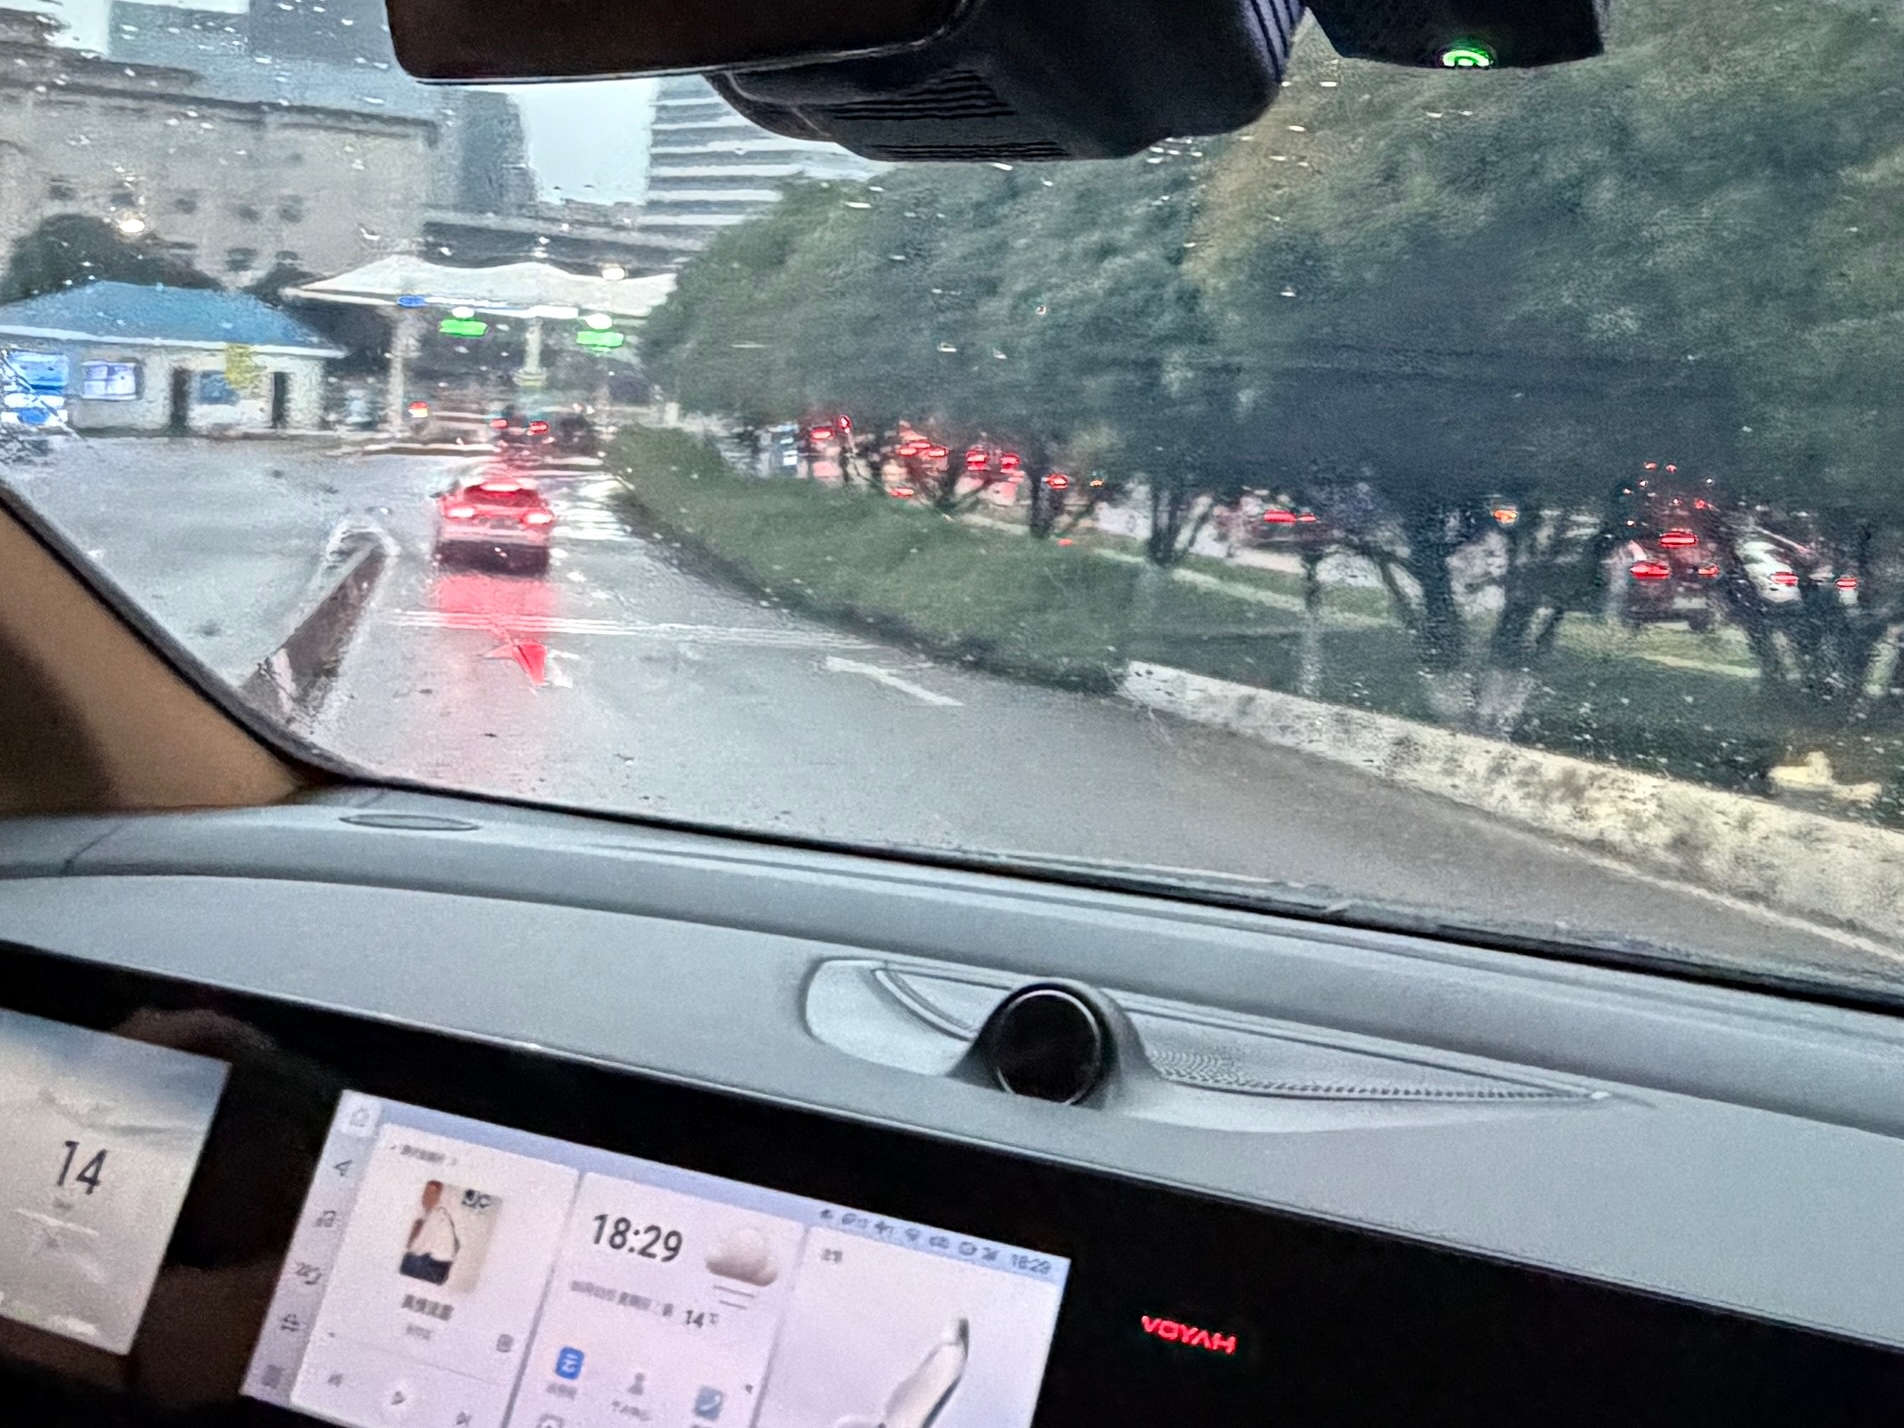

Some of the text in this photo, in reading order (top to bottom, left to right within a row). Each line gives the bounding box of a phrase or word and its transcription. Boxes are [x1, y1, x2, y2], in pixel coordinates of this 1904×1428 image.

[57, 1140, 107, 1195] 14
[593, 1213, 683, 1262] 18:29
[1141, 1315, 1236, 1354] VOYAH
